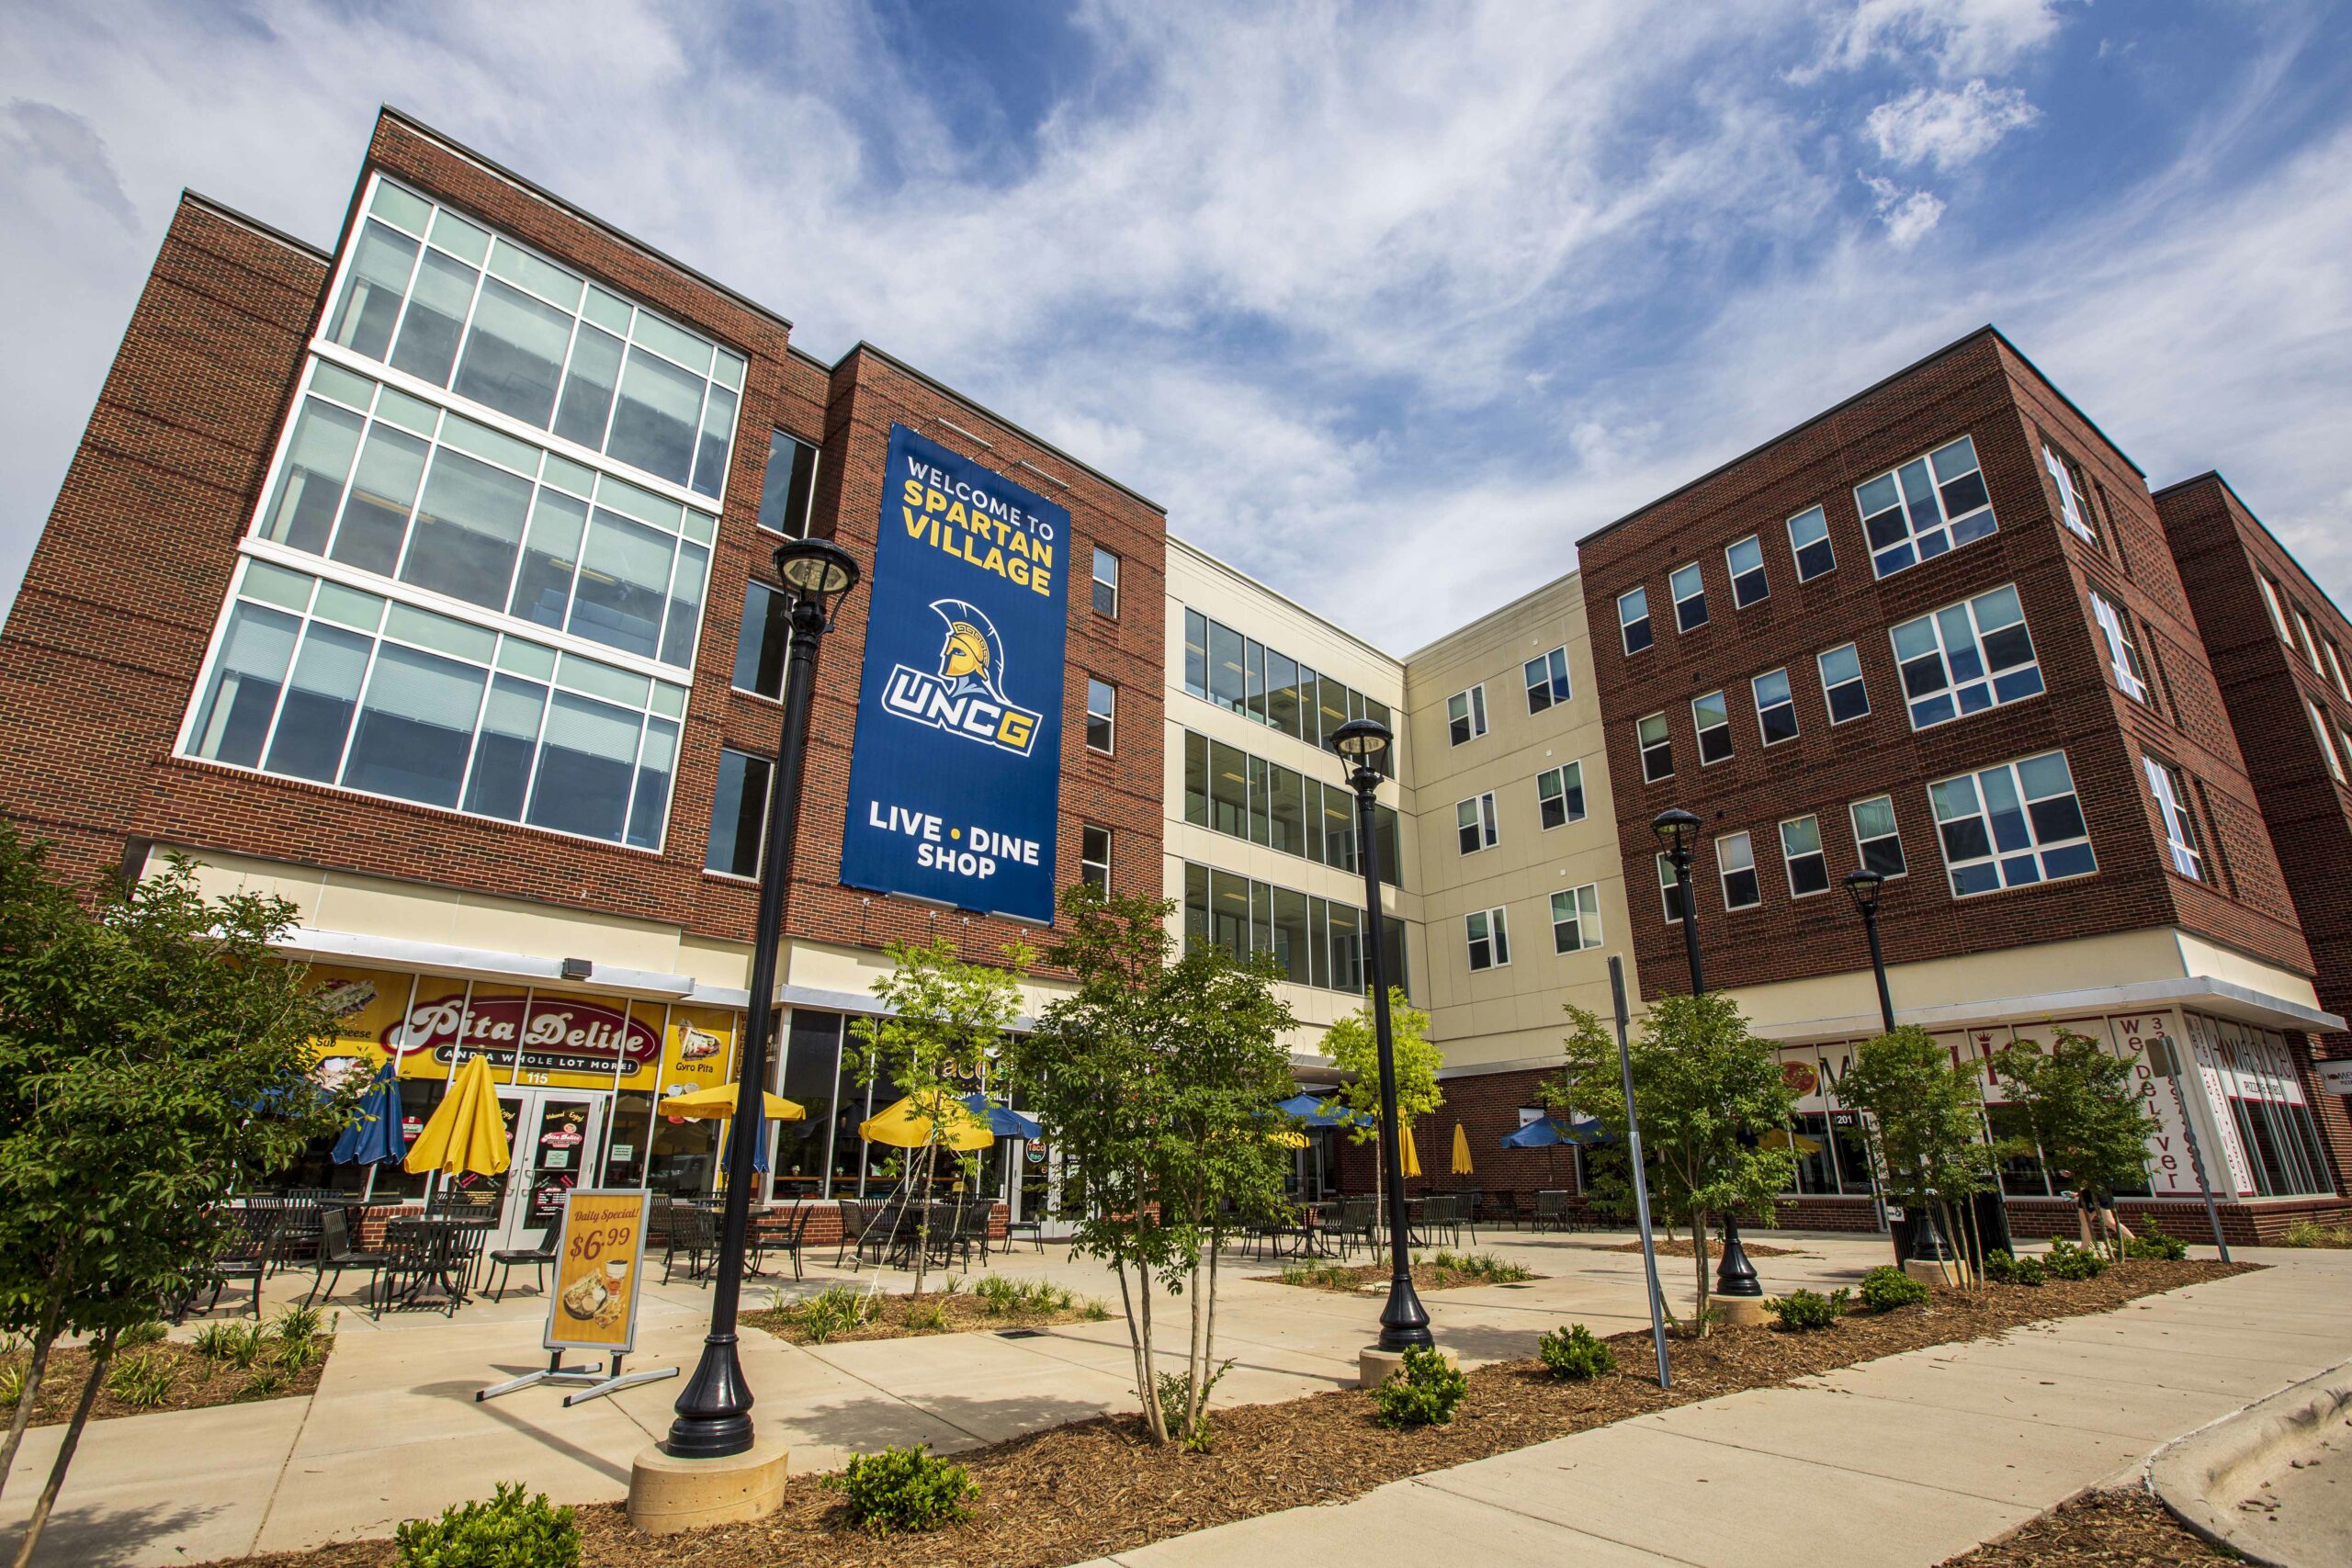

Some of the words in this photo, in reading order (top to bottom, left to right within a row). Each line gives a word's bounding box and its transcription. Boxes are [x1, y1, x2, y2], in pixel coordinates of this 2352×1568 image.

[908, 456, 1022, 527] WELCOME
[1027, 514, 1054, 541] TO
[903, 479, 1053, 569] SPARTAN
[902, 506, 1051, 597] VILLAGE
[889, 673, 1034, 748] UNCG
[869, 800, 943, 842] LIVE
[969, 826, 1040, 866] DINE
[917, 843, 996, 879] SHOP
[389, 999, 515, 1052] Pita
[525, 1012, 644, 1053] Delite
[444, 1050, 477, 1060] AND
[486, 1053, 493, 1061] A
[502, 1054, 553, 1066] WHOLE
[559, 1058, 584, 1067] LOT
[590, 1061, 632, 1070] MORE!
[526, 1071, 549, 1084] 115
[675, 1062, 695, 1072] Gyro
[697, 1064, 713, 1073] Pita
[1837, 1115, 1852, 1124] 201
[1029, 1143, 1045, 1152] Taco
[575, 1211, 600, 1224] Daily
[601, 1208, 639, 1222] Special!
[571, 1227, 630, 1263] $6.99
